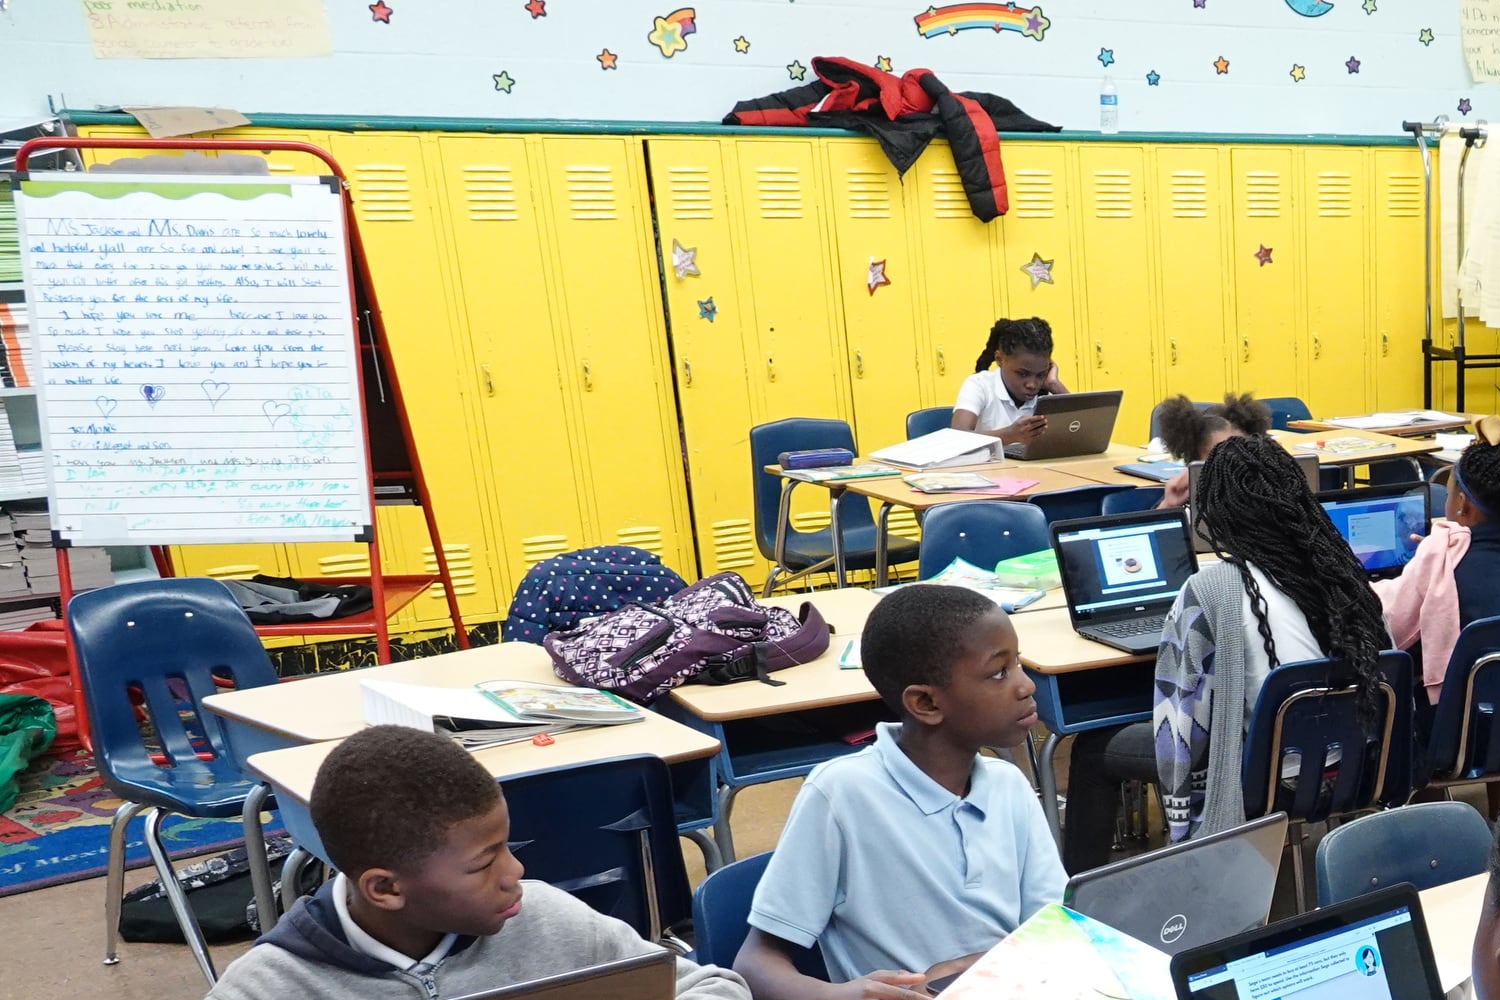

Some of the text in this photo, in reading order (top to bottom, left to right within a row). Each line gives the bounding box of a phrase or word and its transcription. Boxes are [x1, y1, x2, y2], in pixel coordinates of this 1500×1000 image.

[128, 0, 203, 12] mediation
[1472, 7, 1487, 21] Do
[297, 229, 328, 239] lovely
[277, 277, 296, 287] will
[112, 293, 126, 302] for
[135, 294, 149, 302] the
[194, 297, 209, 308] my
[117, 311, 136, 323] you
[229, 309, 273, 319] because
[276, 311, 286, 320] I
[293, 311, 309, 320] love
[311, 344, 326, 352] the
[103, 360, 117, 371] my
[1163, 923, 1184, 936] DELL
